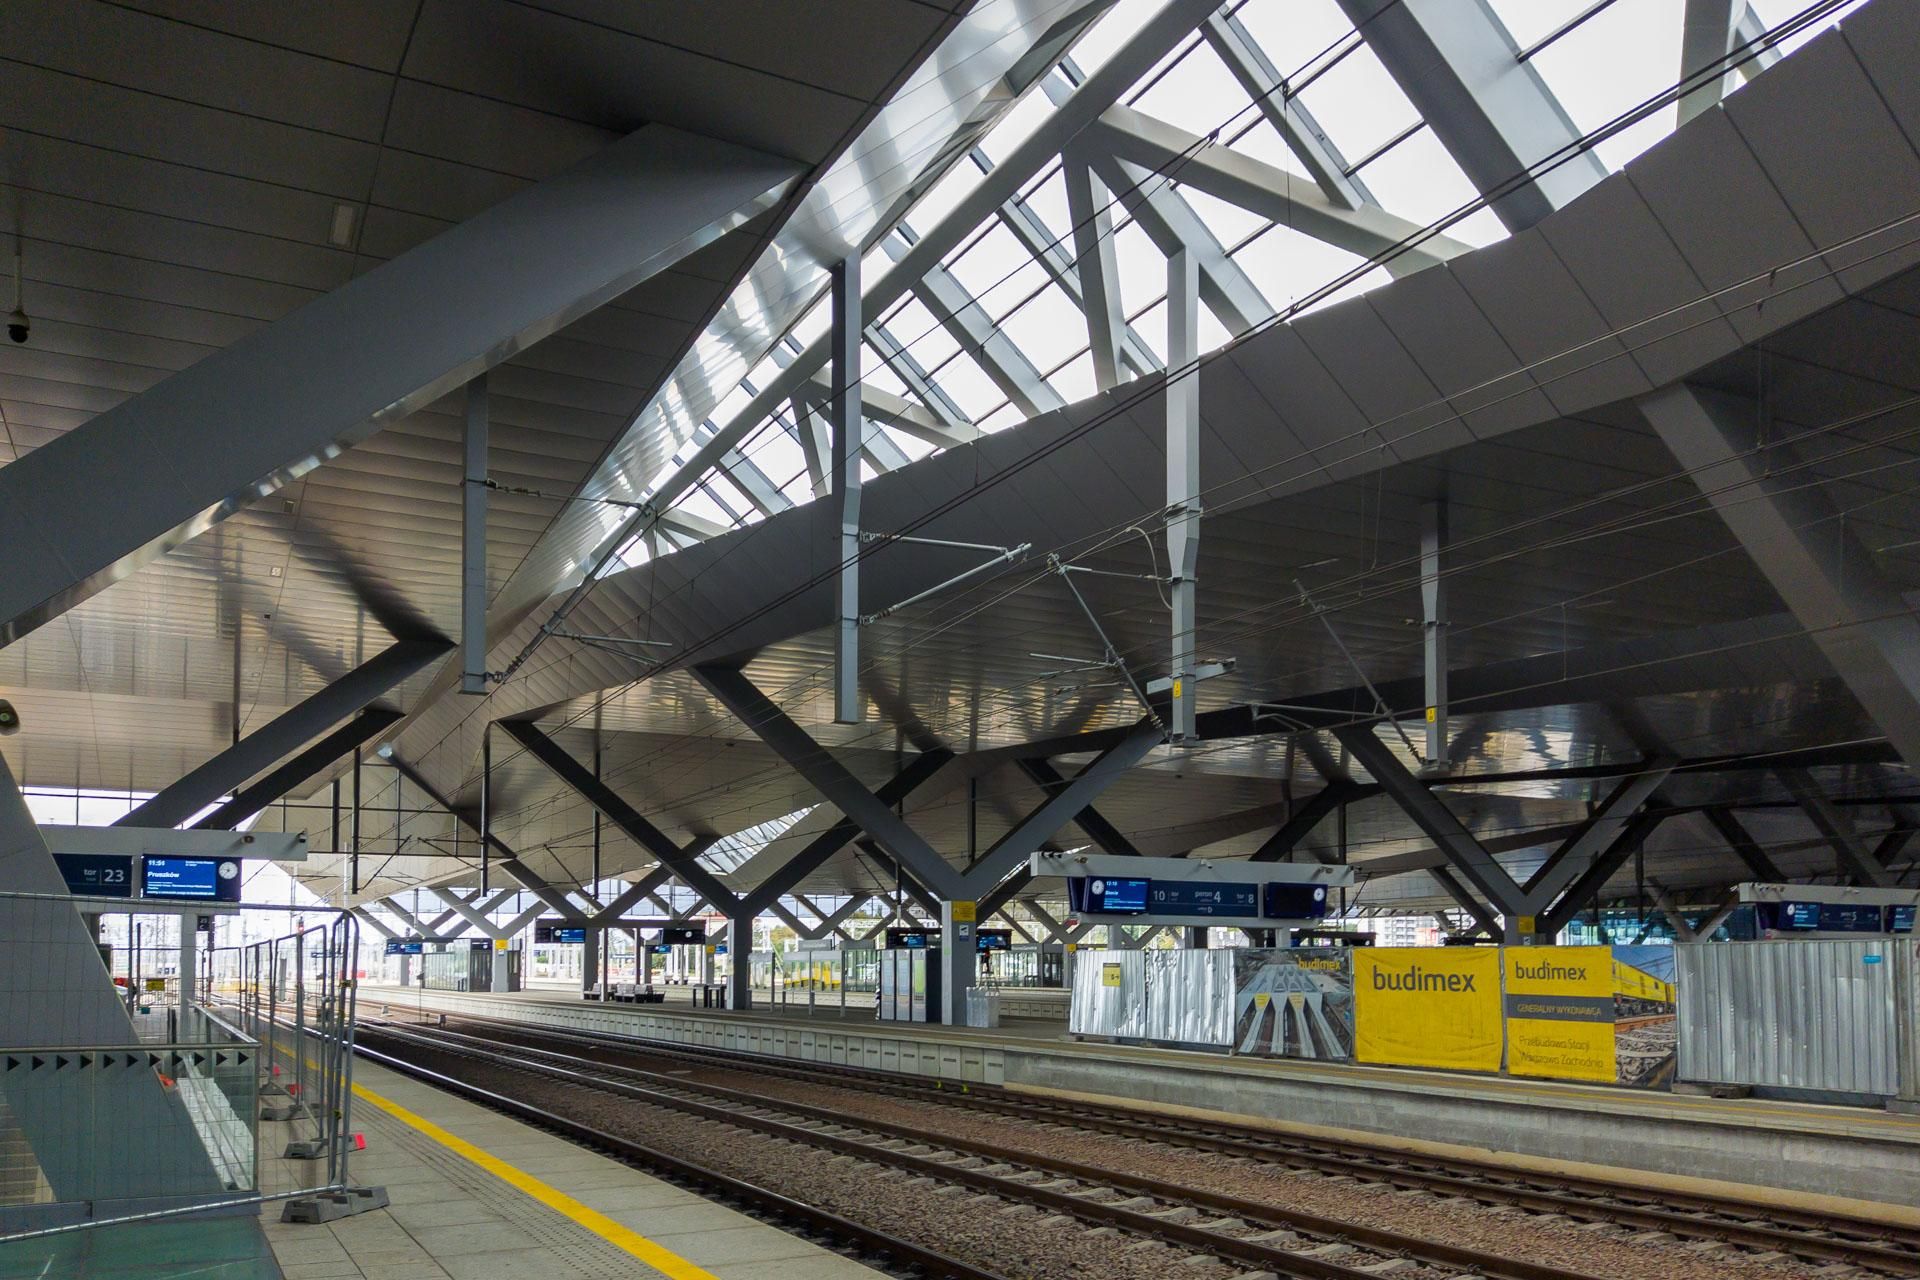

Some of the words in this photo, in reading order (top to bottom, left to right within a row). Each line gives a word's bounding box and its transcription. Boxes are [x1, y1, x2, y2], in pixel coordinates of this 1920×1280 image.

[104, 869, 124, 882] 23
[1153, 890, 1166, 901] 10
[1213, 891, 1221, 903] 4
[1248, 894, 1255, 904] 8
[1298, 958, 1341, 971] budimex
[1515, 960, 1587, 981] budimex
[1373, 965, 1476, 992] budimex
[1519, 1035, 1568, 1049] Przebudowa
[1561, 1055, 1604, 1068] Zachodnia
